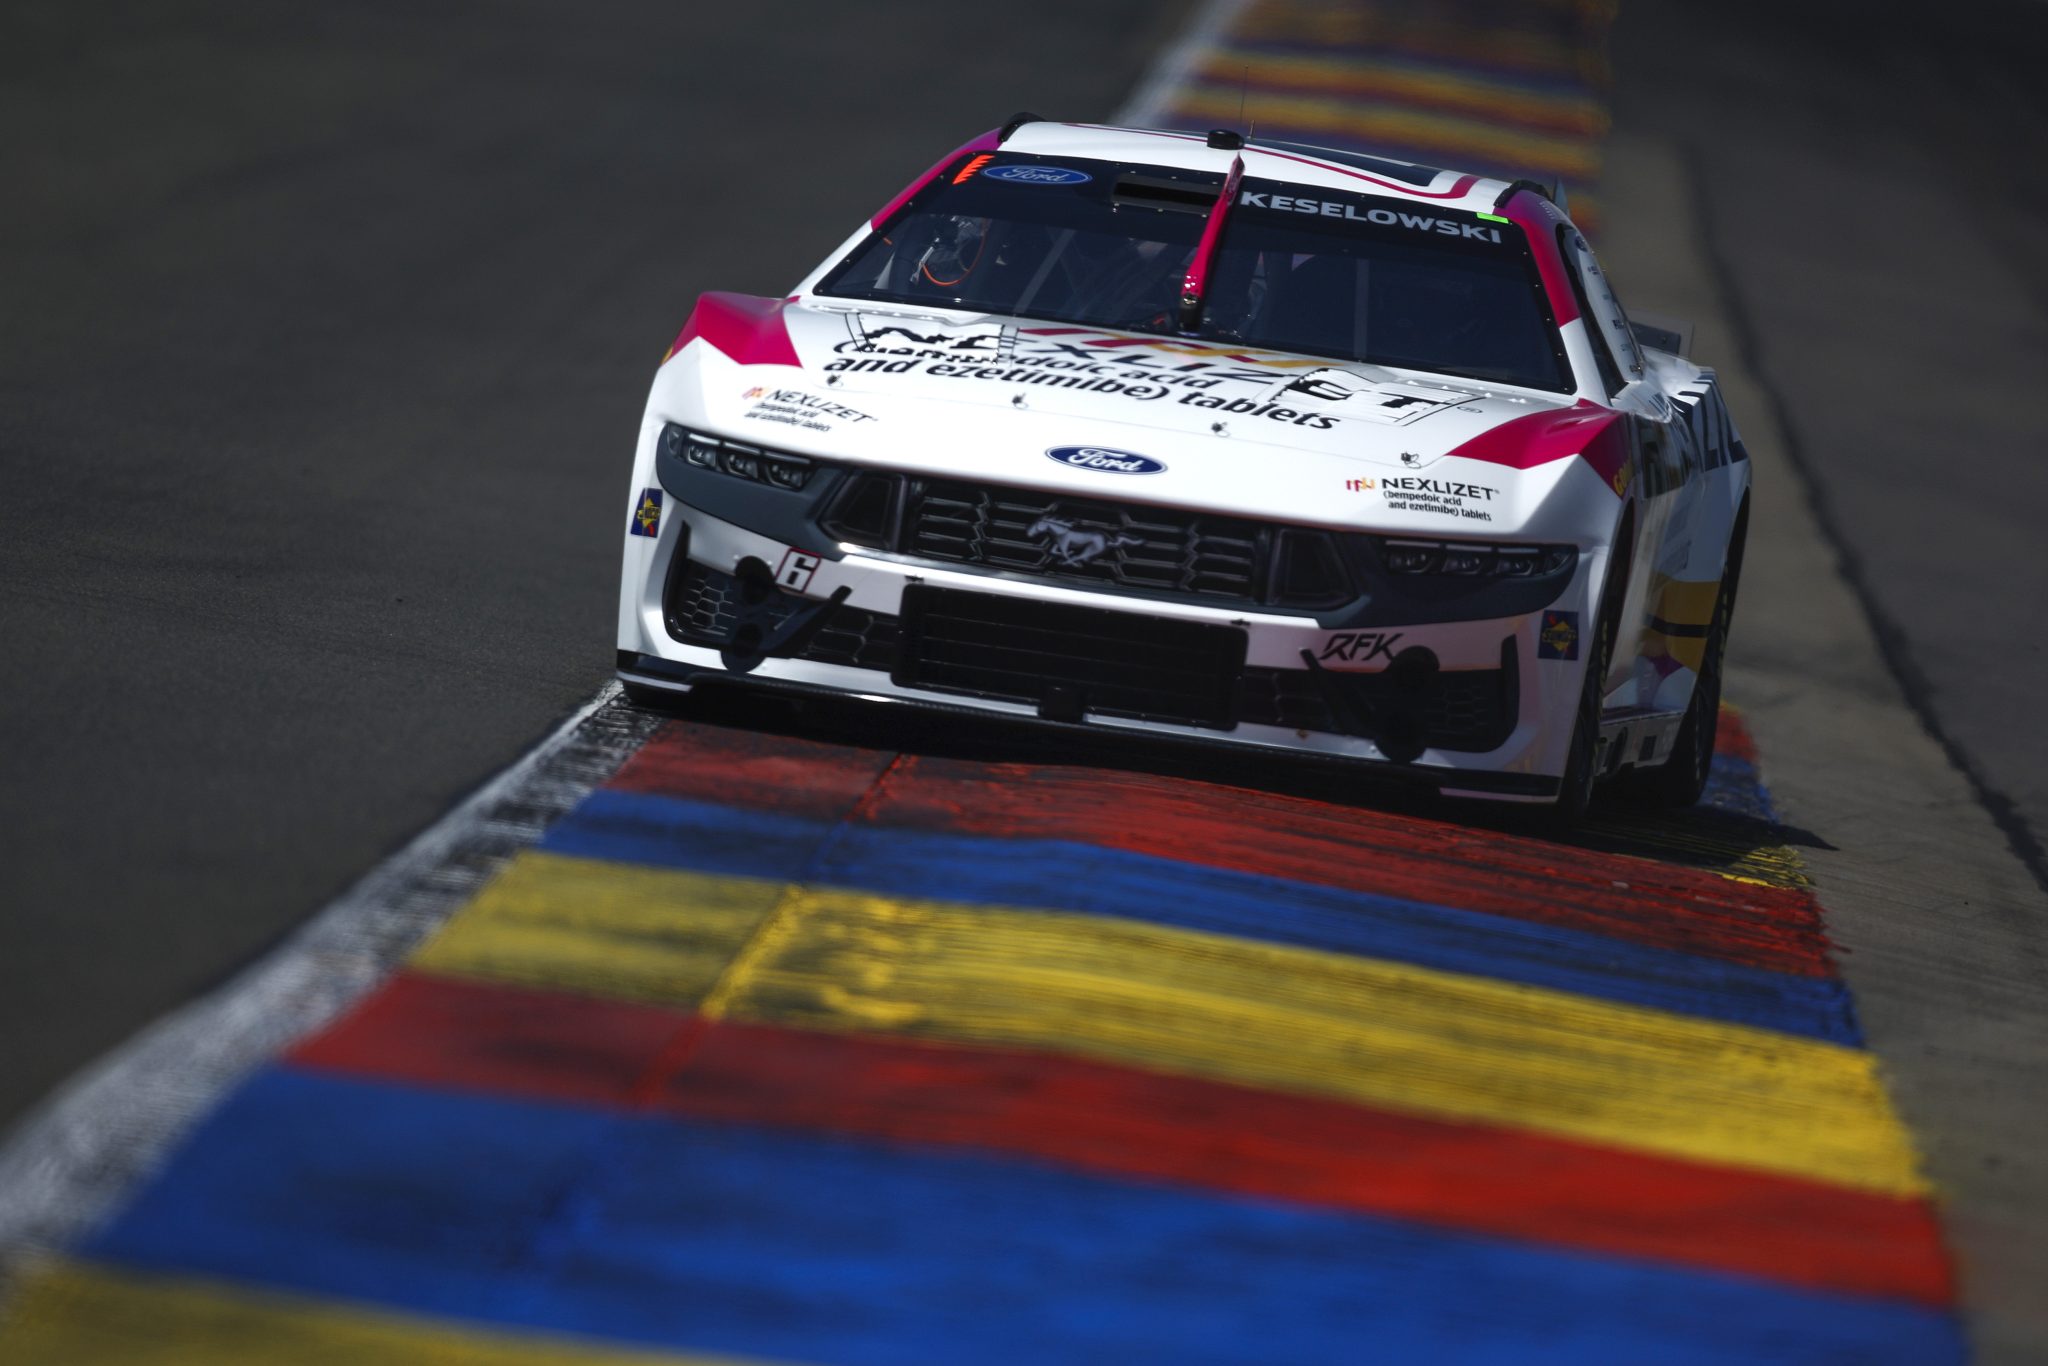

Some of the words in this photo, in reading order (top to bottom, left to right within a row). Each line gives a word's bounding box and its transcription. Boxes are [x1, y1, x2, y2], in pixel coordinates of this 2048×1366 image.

[1002, 168, 1070, 182] Ford
[1239, 191, 1502, 244] KESELOWSKI
[1119, 369, 1223, 389] acid
[764, 389, 874, 423] NEXLIZET
[823, 358, 922, 373] and
[926, 363, 1170, 400] ezetimibe)
[1178, 391, 1341, 430] tablets
[1068, 448, 1144, 471] Ford
[1381, 477, 1494, 501] NEXLIZET
[1383, 490, 1441, 504] (bempedoic
[1442, 496, 1463, 507] acid
[1388, 500, 1407, 510] and
[1408, 502, 1460, 517] ezetimibe)
[1461, 508, 1493, 522] tablets
[774, 546, 822, 594] 6
[1318, 633, 1404, 661] RFK
